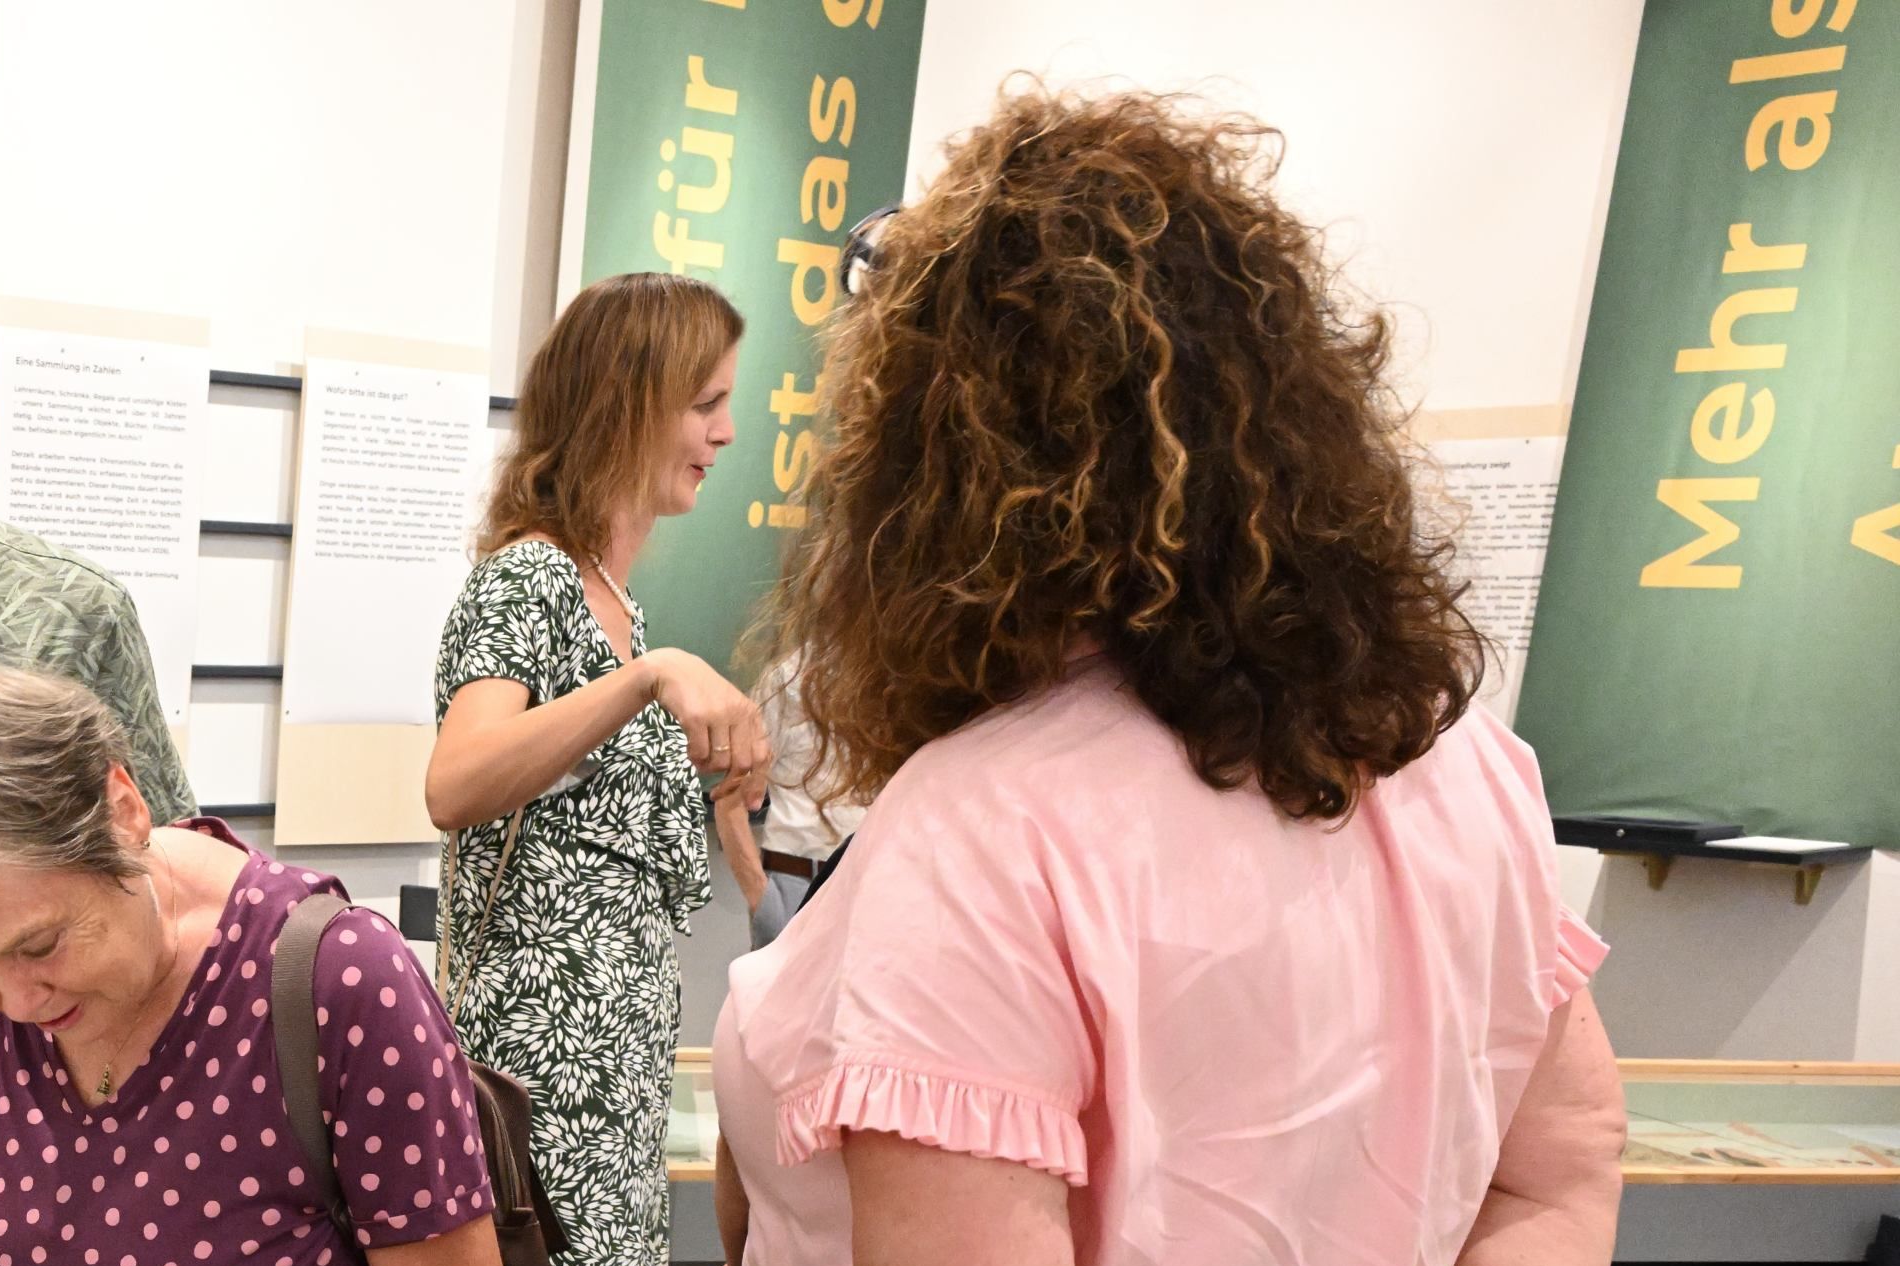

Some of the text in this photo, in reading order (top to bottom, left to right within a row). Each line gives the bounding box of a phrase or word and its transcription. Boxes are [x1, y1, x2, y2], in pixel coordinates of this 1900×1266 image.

[653, 55, 738, 274] für
[776, 74, 857, 326] das
[16, 356, 122, 375] Eine Sammlung in Zahlen
[1639, 0, 1858, 589] Mehr als
[326, 386, 348, 395] Wofür
[348, 388, 367, 396] bitte
[366, 389, 377, 397] ist
[377, 390, 391, 398] das
[748, 372, 820, 528] ist
[1489, 461, 1510, 470] zeigt
